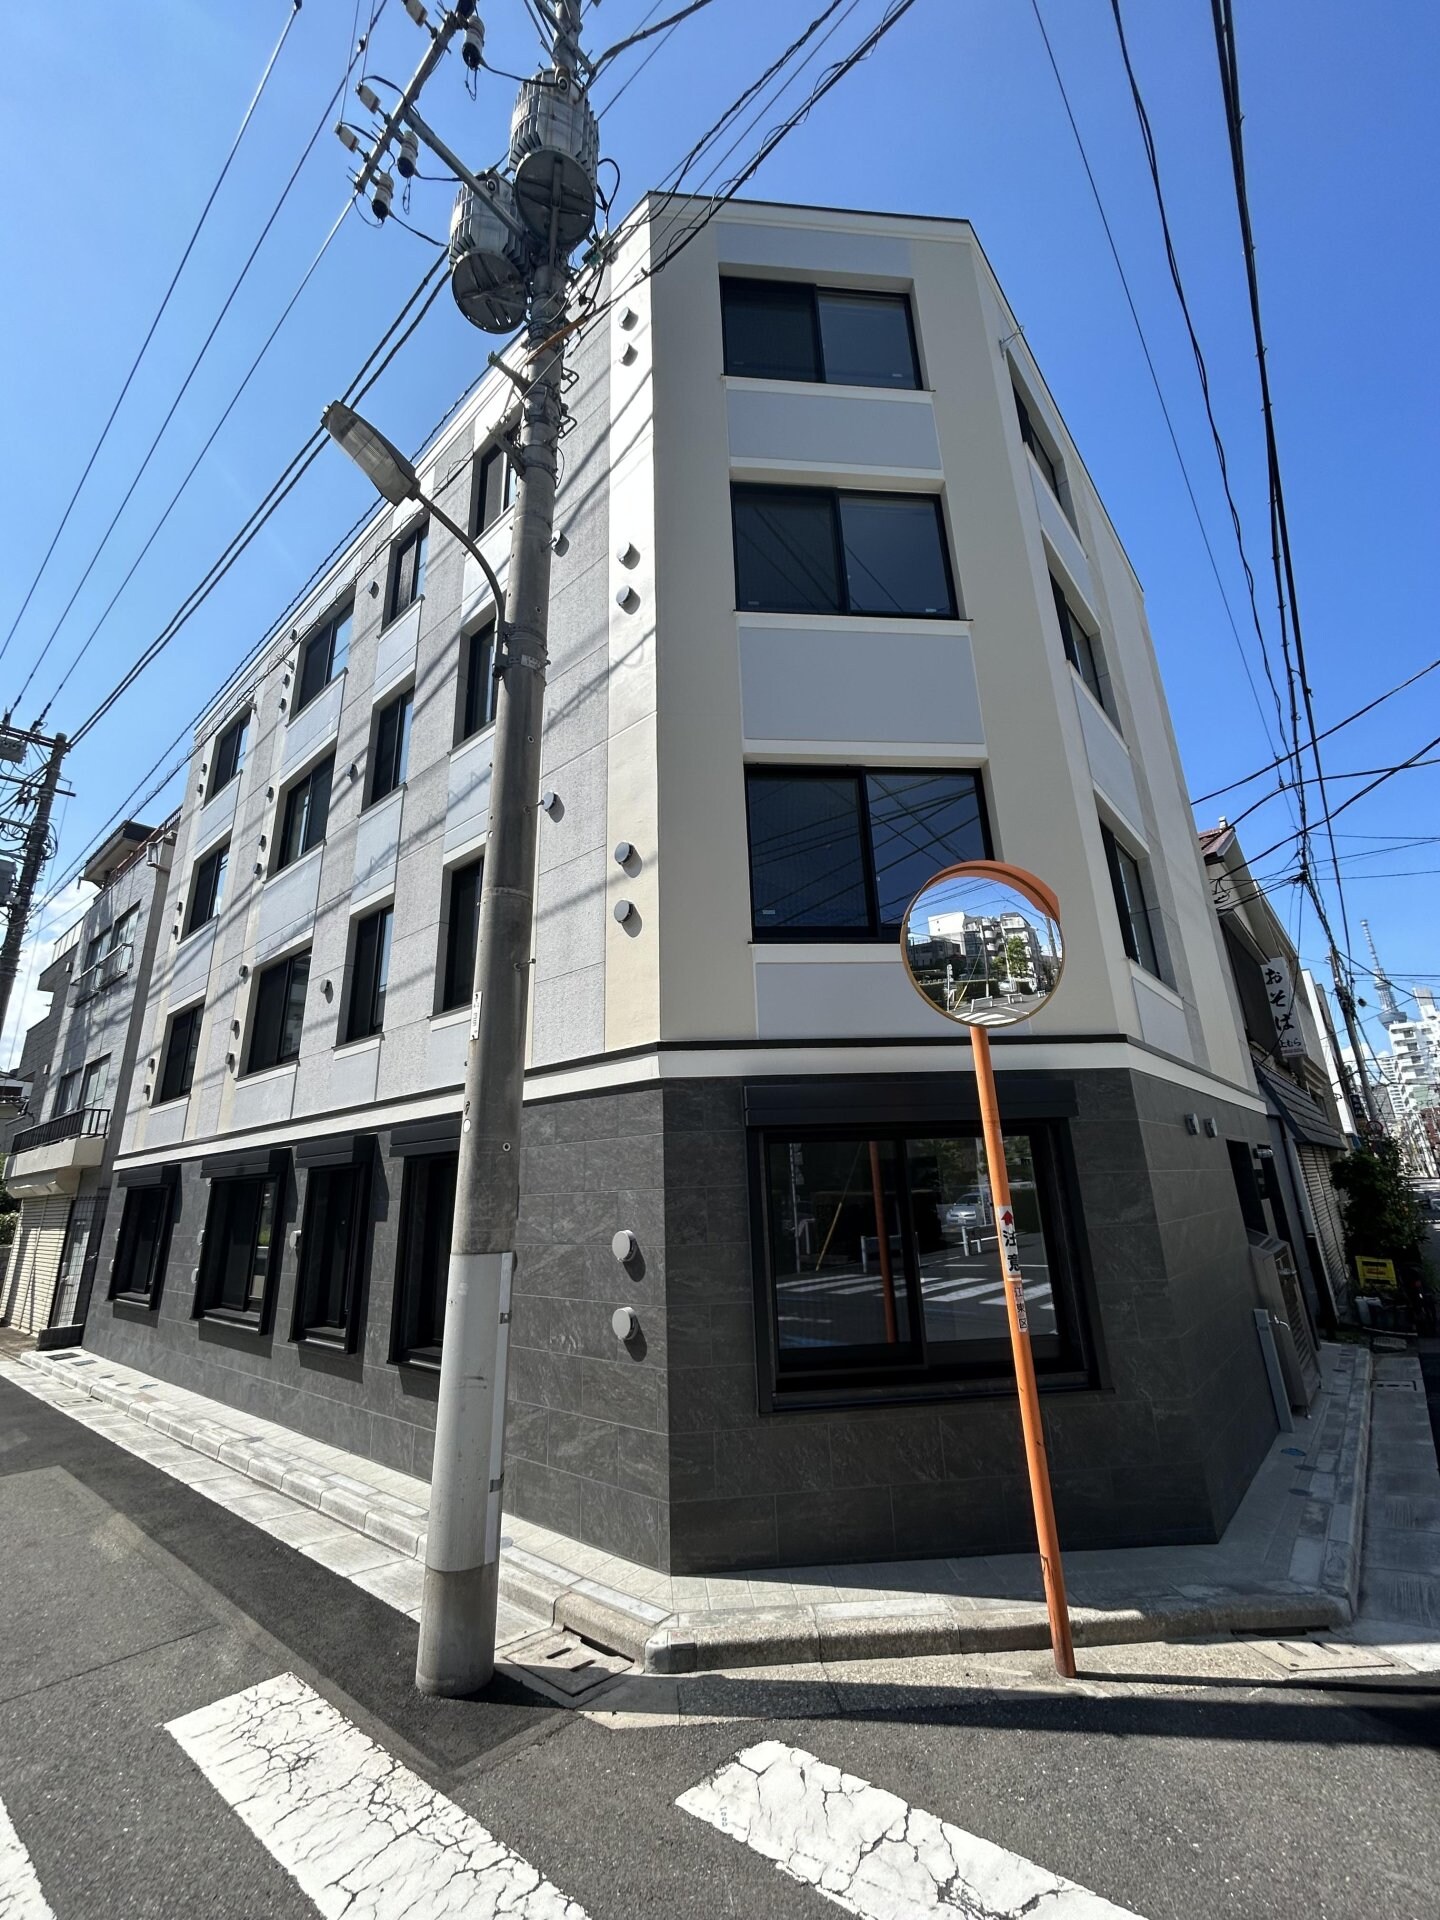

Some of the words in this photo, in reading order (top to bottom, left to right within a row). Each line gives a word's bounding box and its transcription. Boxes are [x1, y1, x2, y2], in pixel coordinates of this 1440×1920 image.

[1264, 967, 1294, 1031] おそば
[1014, 1287, 1028, 1329] 江東区
